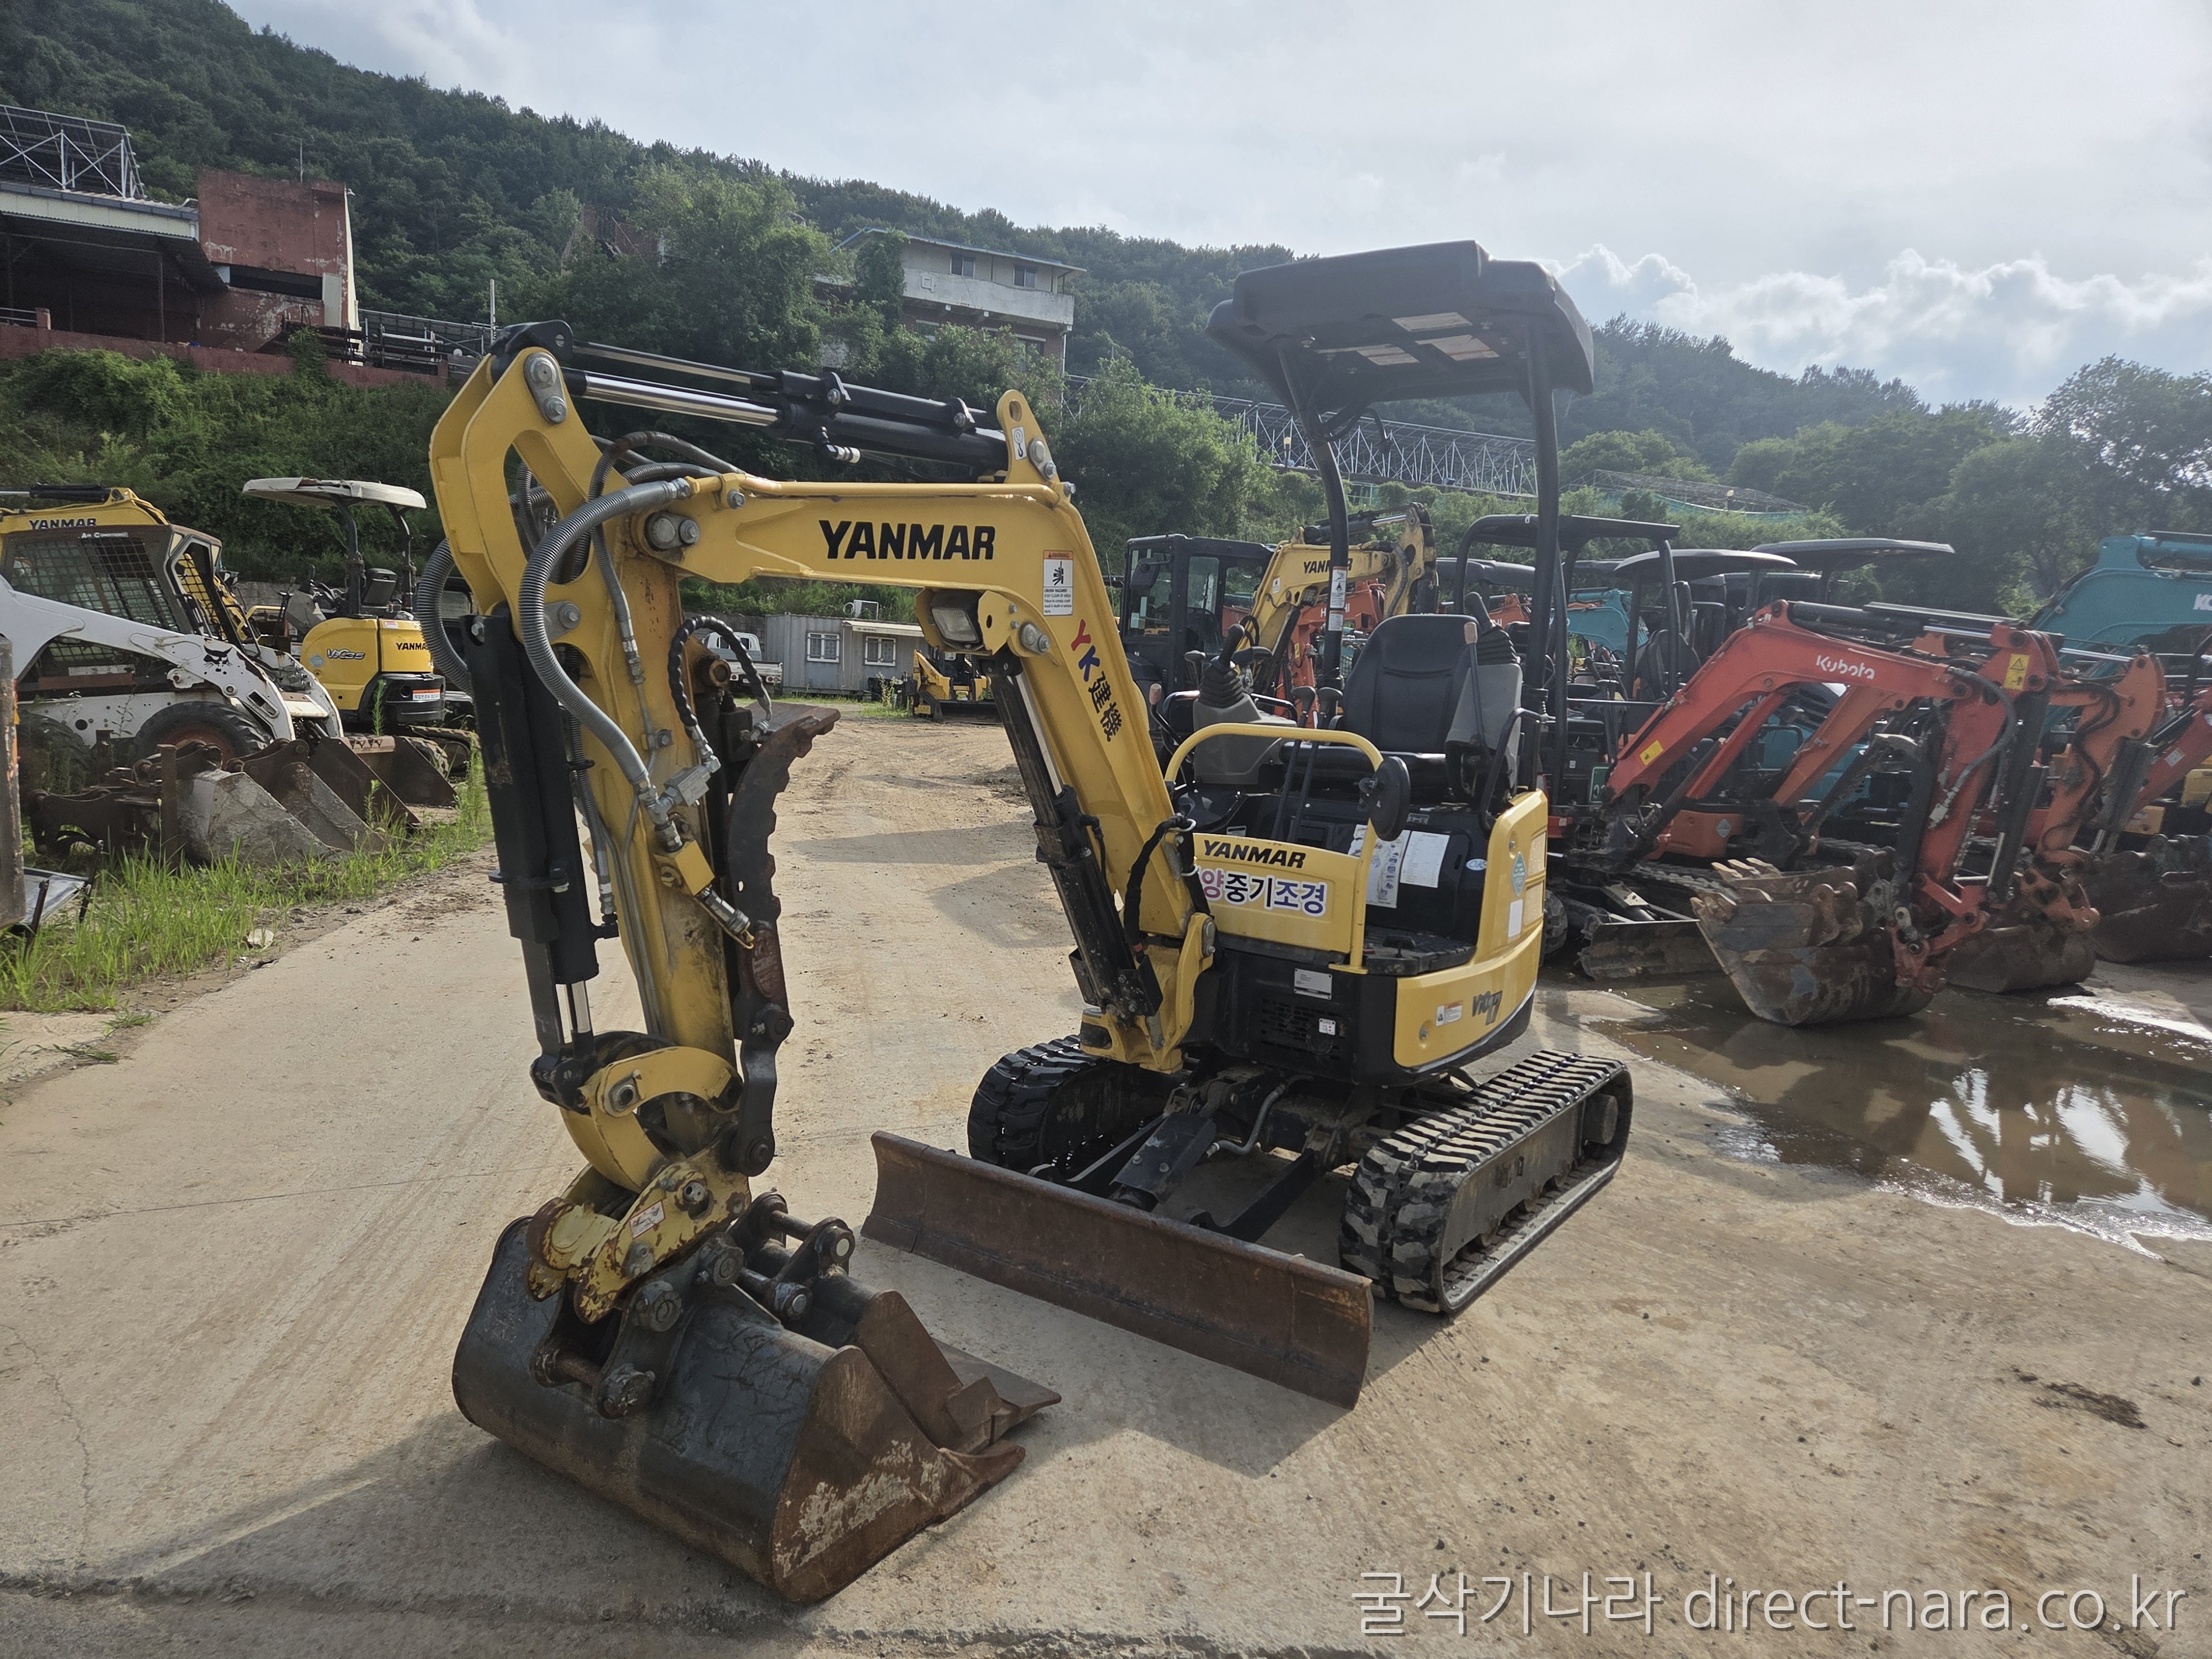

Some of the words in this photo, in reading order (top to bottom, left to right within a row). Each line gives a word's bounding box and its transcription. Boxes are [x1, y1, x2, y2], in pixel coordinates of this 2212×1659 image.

[818, 520, 995, 560] YANMAR
[1303, 558, 1353, 573] YANR
[1815, 655, 1875, 680] Kubota
[1204, 839, 1306, 869] YANMAR
[1198, 868, 1325, 914] 양중기조경
